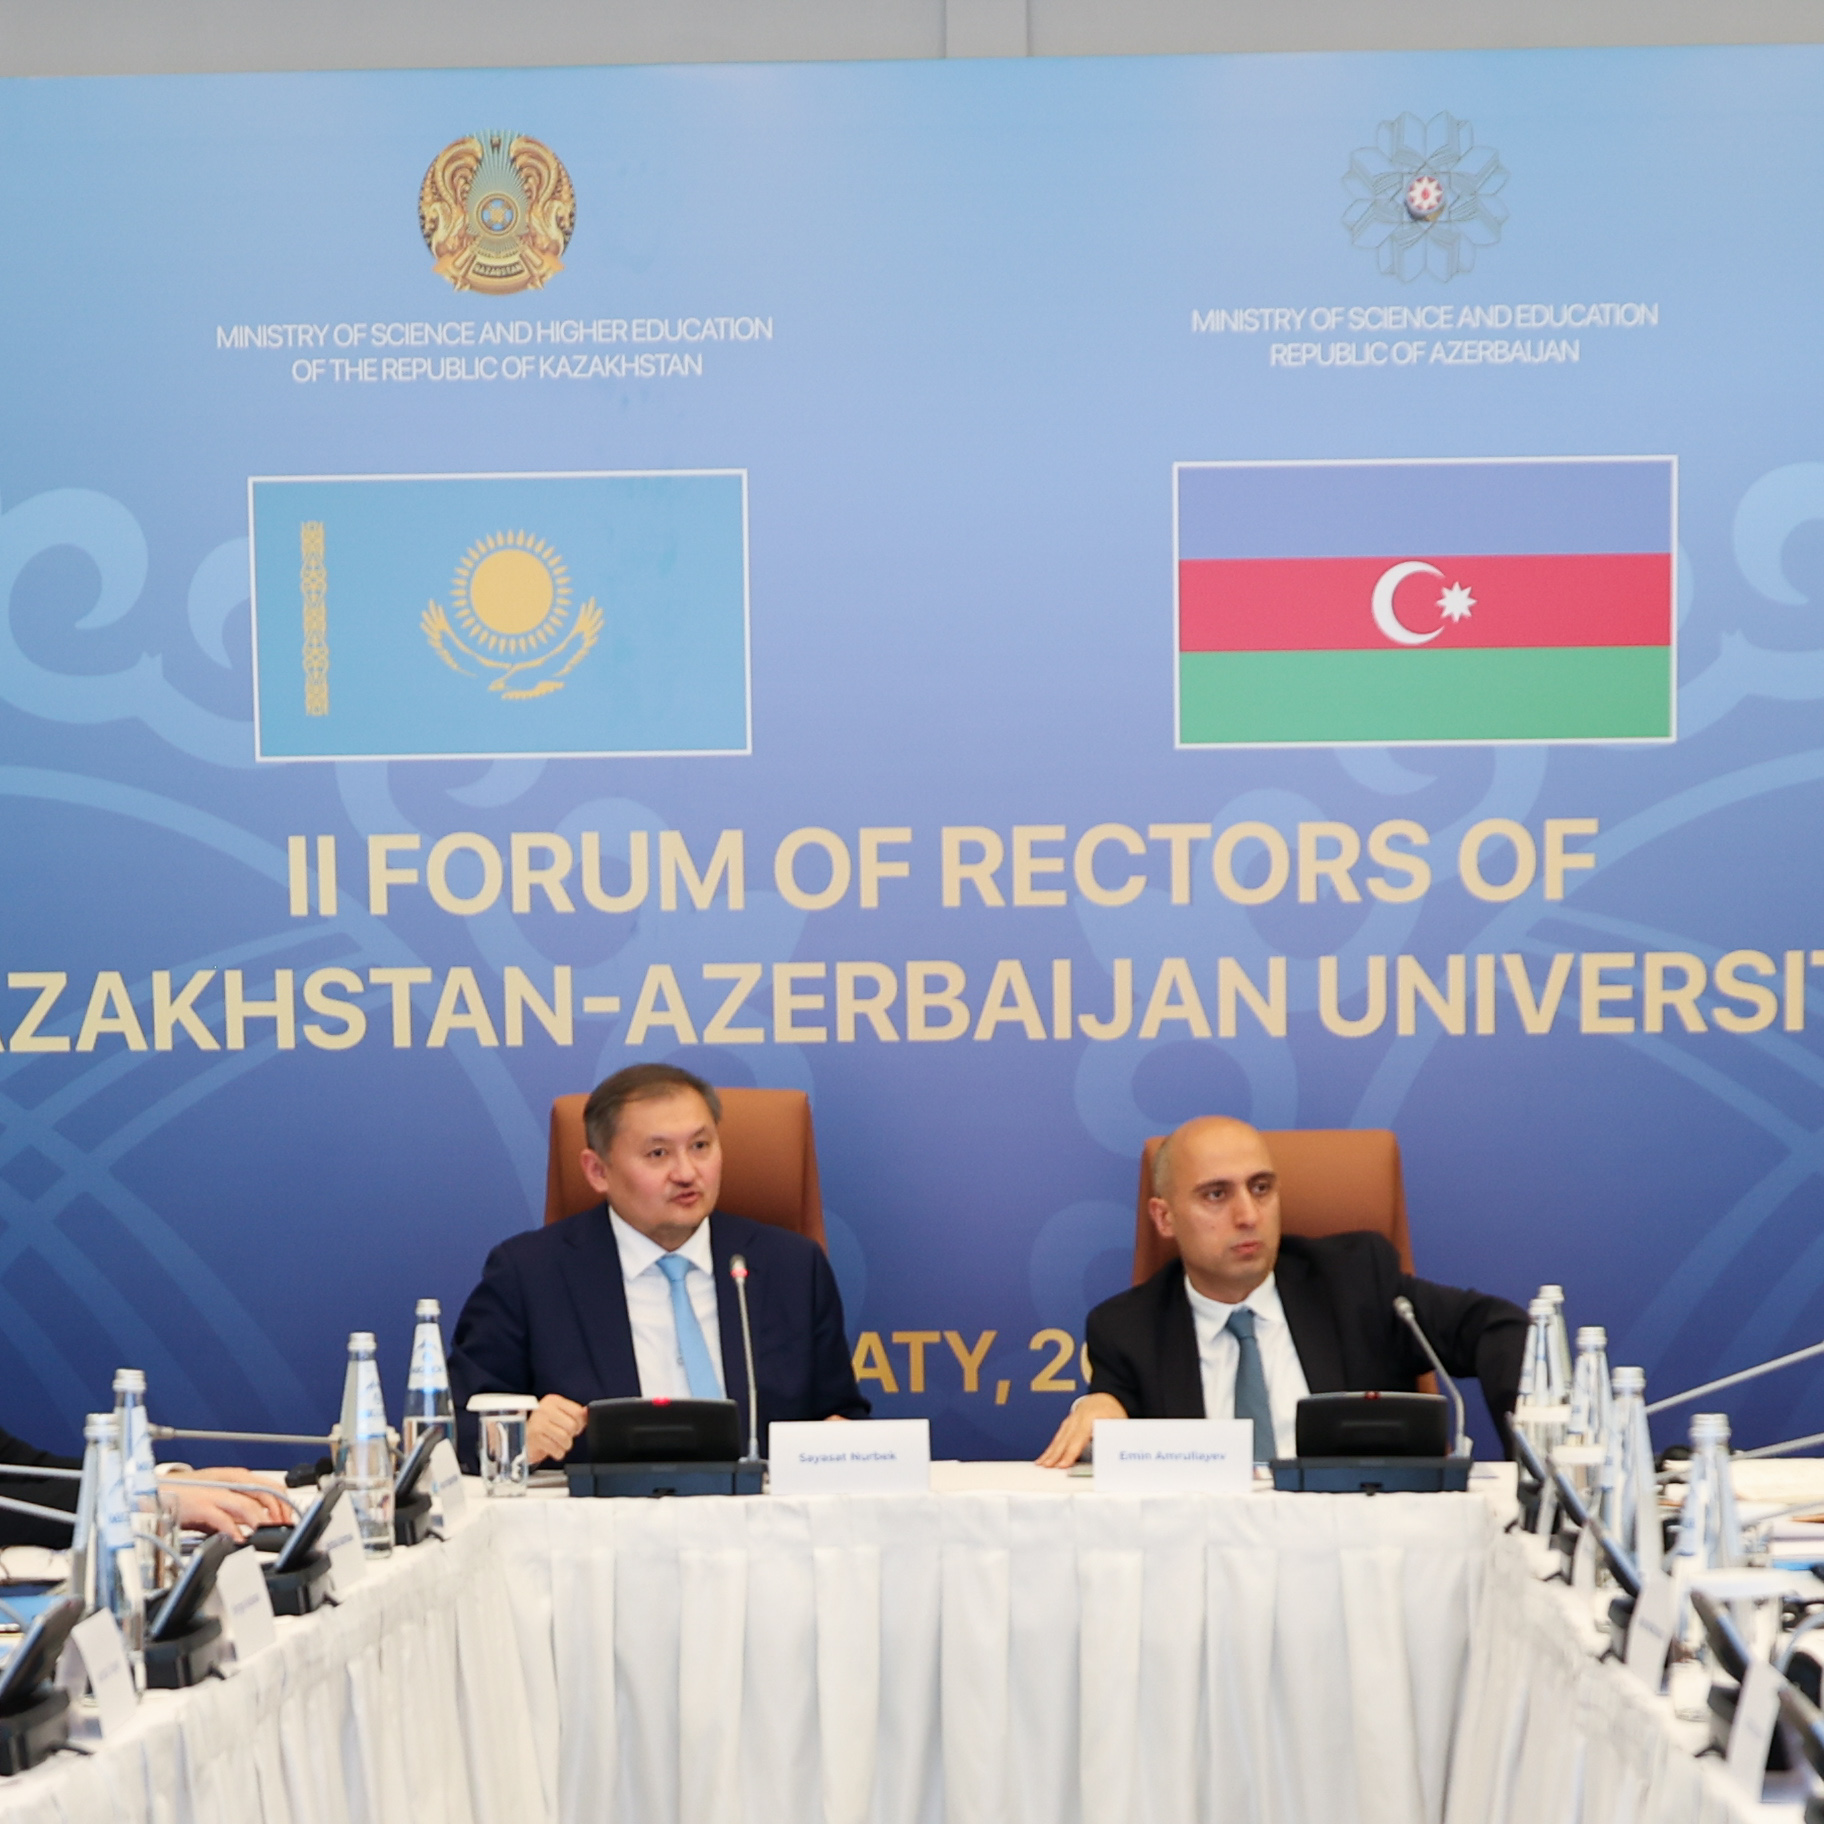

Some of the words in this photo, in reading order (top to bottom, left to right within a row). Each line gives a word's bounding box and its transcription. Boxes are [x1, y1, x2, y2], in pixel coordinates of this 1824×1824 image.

[1192, 307, 1307, 332] MINISTRY
[1310, 306, 1345, 331] OF
[1348, 305, 1454, 330] SCIENCE
[1457, 304, 1513, 329] AND
[1516, 302, 1659, 328] EDUCATION
[216, 323, 329, 349] MINISTRY
[333, 322, 367, 347] OF
[371, 321, 475, 346] SCIENCE
[479, 320, 533, 345] AND
[536, 318, 628, 344] HIGHER
[631, 316, 774, 343] EDUCATION
[291, 358, 326, 383] OF
[329, 357, 377, 382] THE
[381, 356, 498, 382] REPUBLIC
[501, 354, 535, 380] OF
[539, 353, 703, 379] KAZAKHSTAN
[1270, 341, 1388, 367] REPUBLIC
[1392, 341, 1426, 365] OF
[1429, 339, 1580, 365] AZERBAIJAN
[288, 835, 339, 916] II
[367, 829, 745, 915] FORUM
[773, 827, 913, 911] OF
[941, 819, 1432, 908] RECTORS
[1459, 818, 1599, 903] OF
